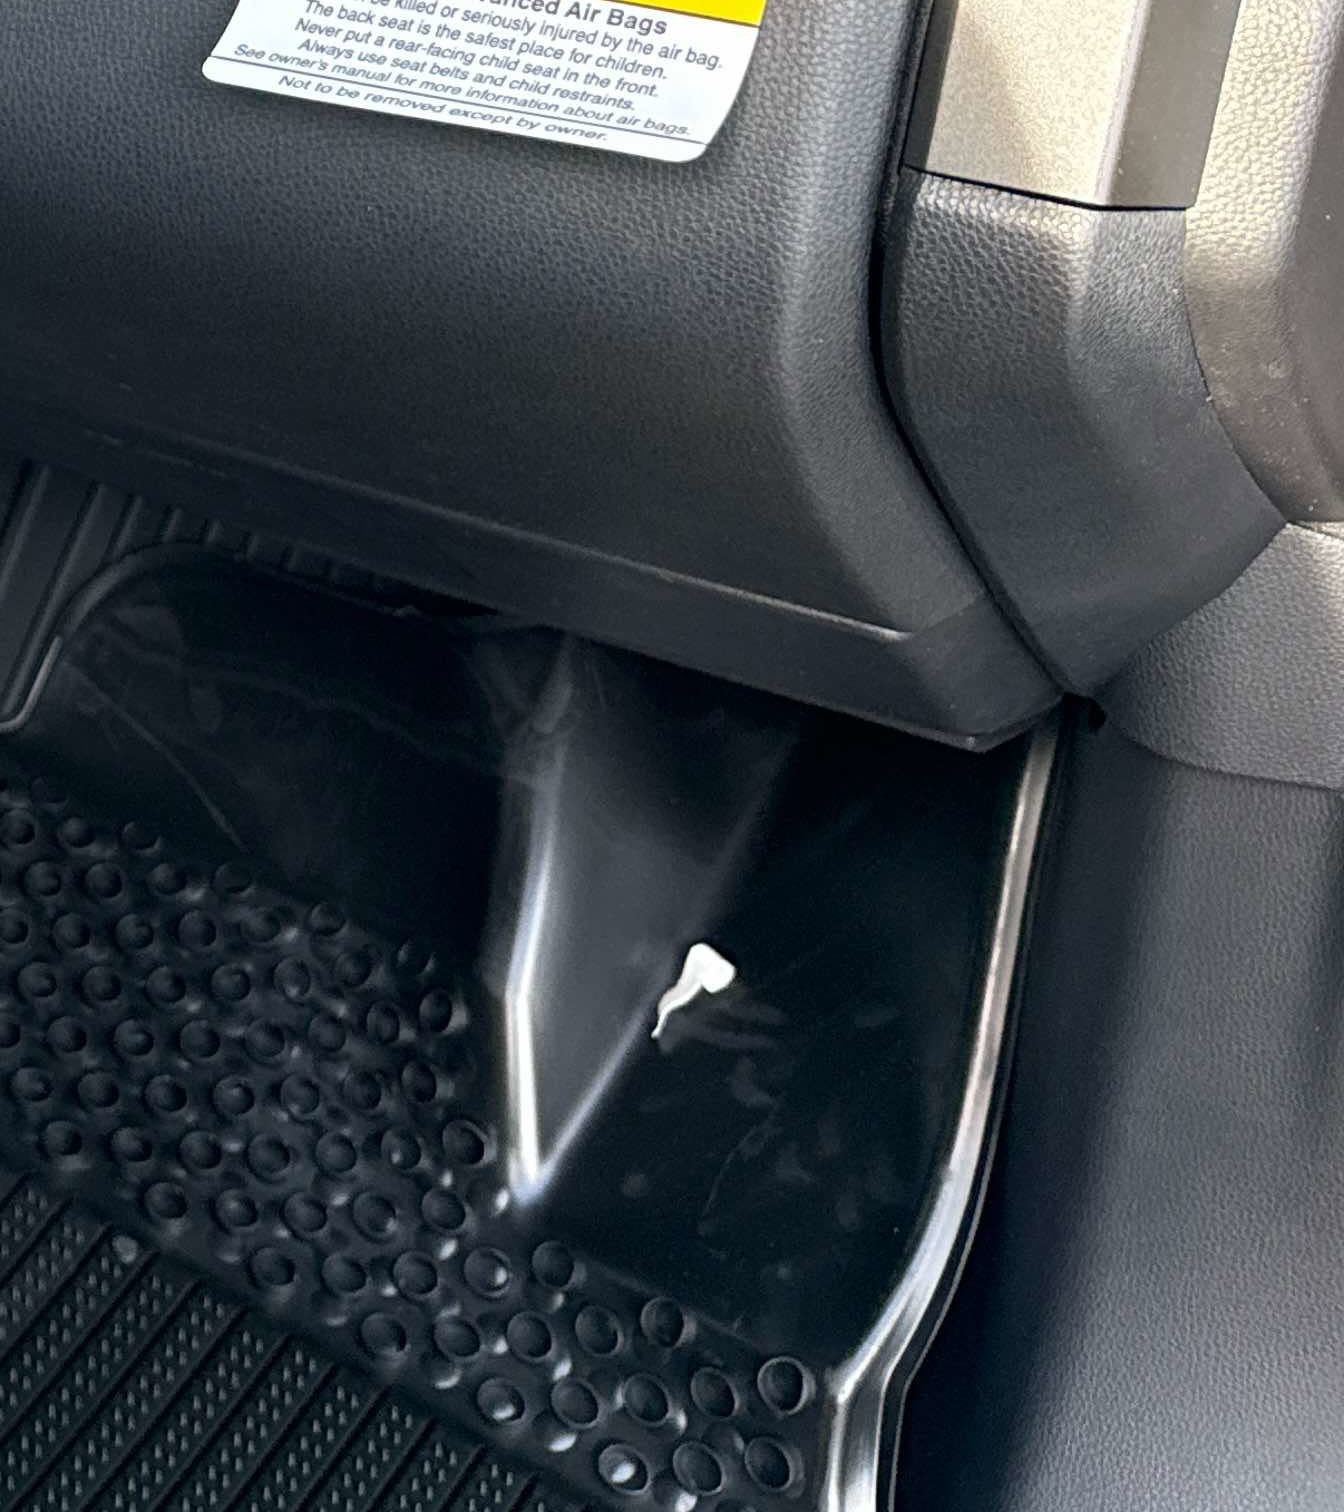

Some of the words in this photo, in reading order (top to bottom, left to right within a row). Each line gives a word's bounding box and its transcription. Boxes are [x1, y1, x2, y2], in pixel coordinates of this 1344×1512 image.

[337, 5, 376, 25] back
[378, 14, 414, 31] seat
[416, 19, 431, 36] is
[435, 23, 462, 41] the
[464, 31, 517, 51] safest
[516, 39, 565, 60] place
[568, 47, 592, 65] for
[595, 55, 668, 80] children.
[440, 6, 459, 19] or
[461, 8, 536, 36] seriously
[539, 20, 598, 45] injured
[600, 31, 623, 52] by
[626, 37, 654, 55] the
[658, 43, 683, 60] air
[685, 47, 723, 71] bag.
[564, 1, 601, 22] Air
[606, 8, 668, 36] Bags
[234, 43, 266, 59] See
[268, 51, 329, 72] owner's
[331, 64, 392, 83] manual
[394, 73, 418, 87] for
[418, 80, 463, 96] more
[465, 85, 560, 113] information
[562, 105, 615, 123] about
[616, 115, 642, 128] air
[643, 117, 691, 136] bags.
[294, 17, 344, 38] Never
[343, 29, 372, 44] put
[373, 35, 385, 47] a
[388, 37, 476, 66] rear-facing
[479, 53, 520, 72] child
[522, 62, 561, 80] seat
[563, 67, 580, 83] in
[583, 72, 611, 89] the
[615, 77, 659, 98] front.
[297, 38, 355, 60] Always
[357, 51, 388, 66] use
[390, 56, 428, 73] seat
[429, 62, 470, 80] belts
[472, 72, 507, 88] and
[508, 78, 551, 96] child
[552, 84, 636, 111] restraints.
[278, 74, 312, 90] Not
[314, 81, 334, 94] to
[336, 85, 361, 99] be
[363, 91, 447, 114] removed
[448, 106, 513, 126] except
[516, 116, 541, 130] by
[543, 122, 608, 141] owner.
